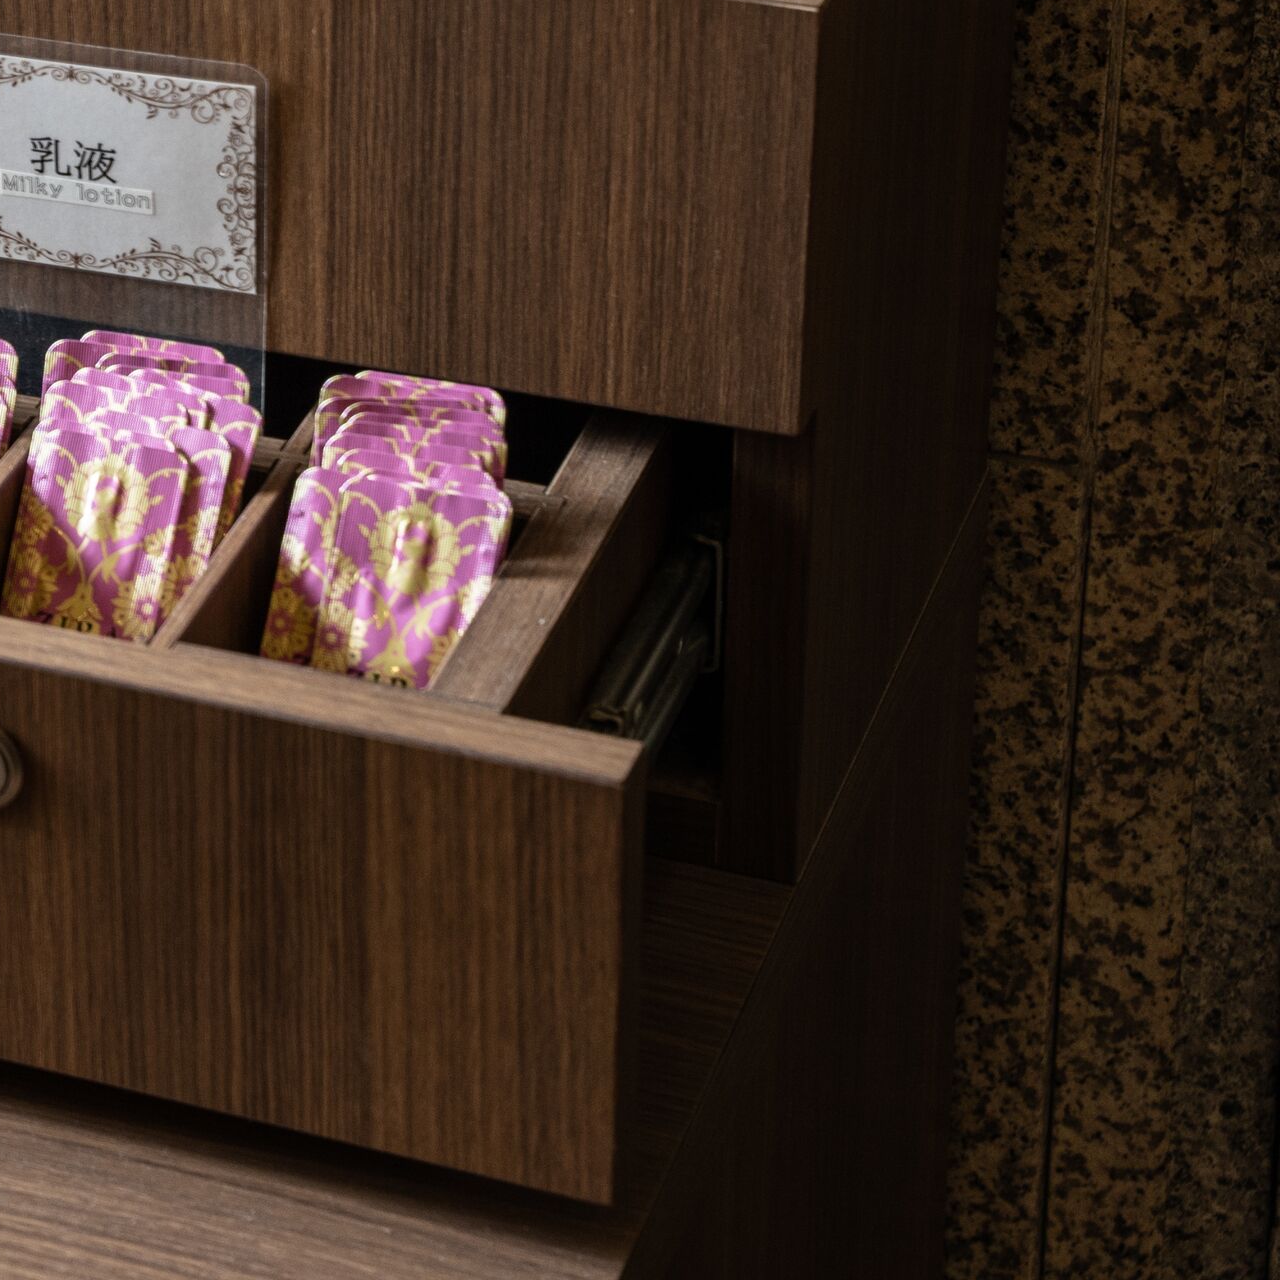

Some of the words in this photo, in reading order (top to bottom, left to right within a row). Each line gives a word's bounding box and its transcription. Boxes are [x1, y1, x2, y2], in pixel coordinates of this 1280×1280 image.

[28, 136, 118, 184] 乳液
[1, 171, 64, 199] Milky
[76, 185, 152, 211] lotion
